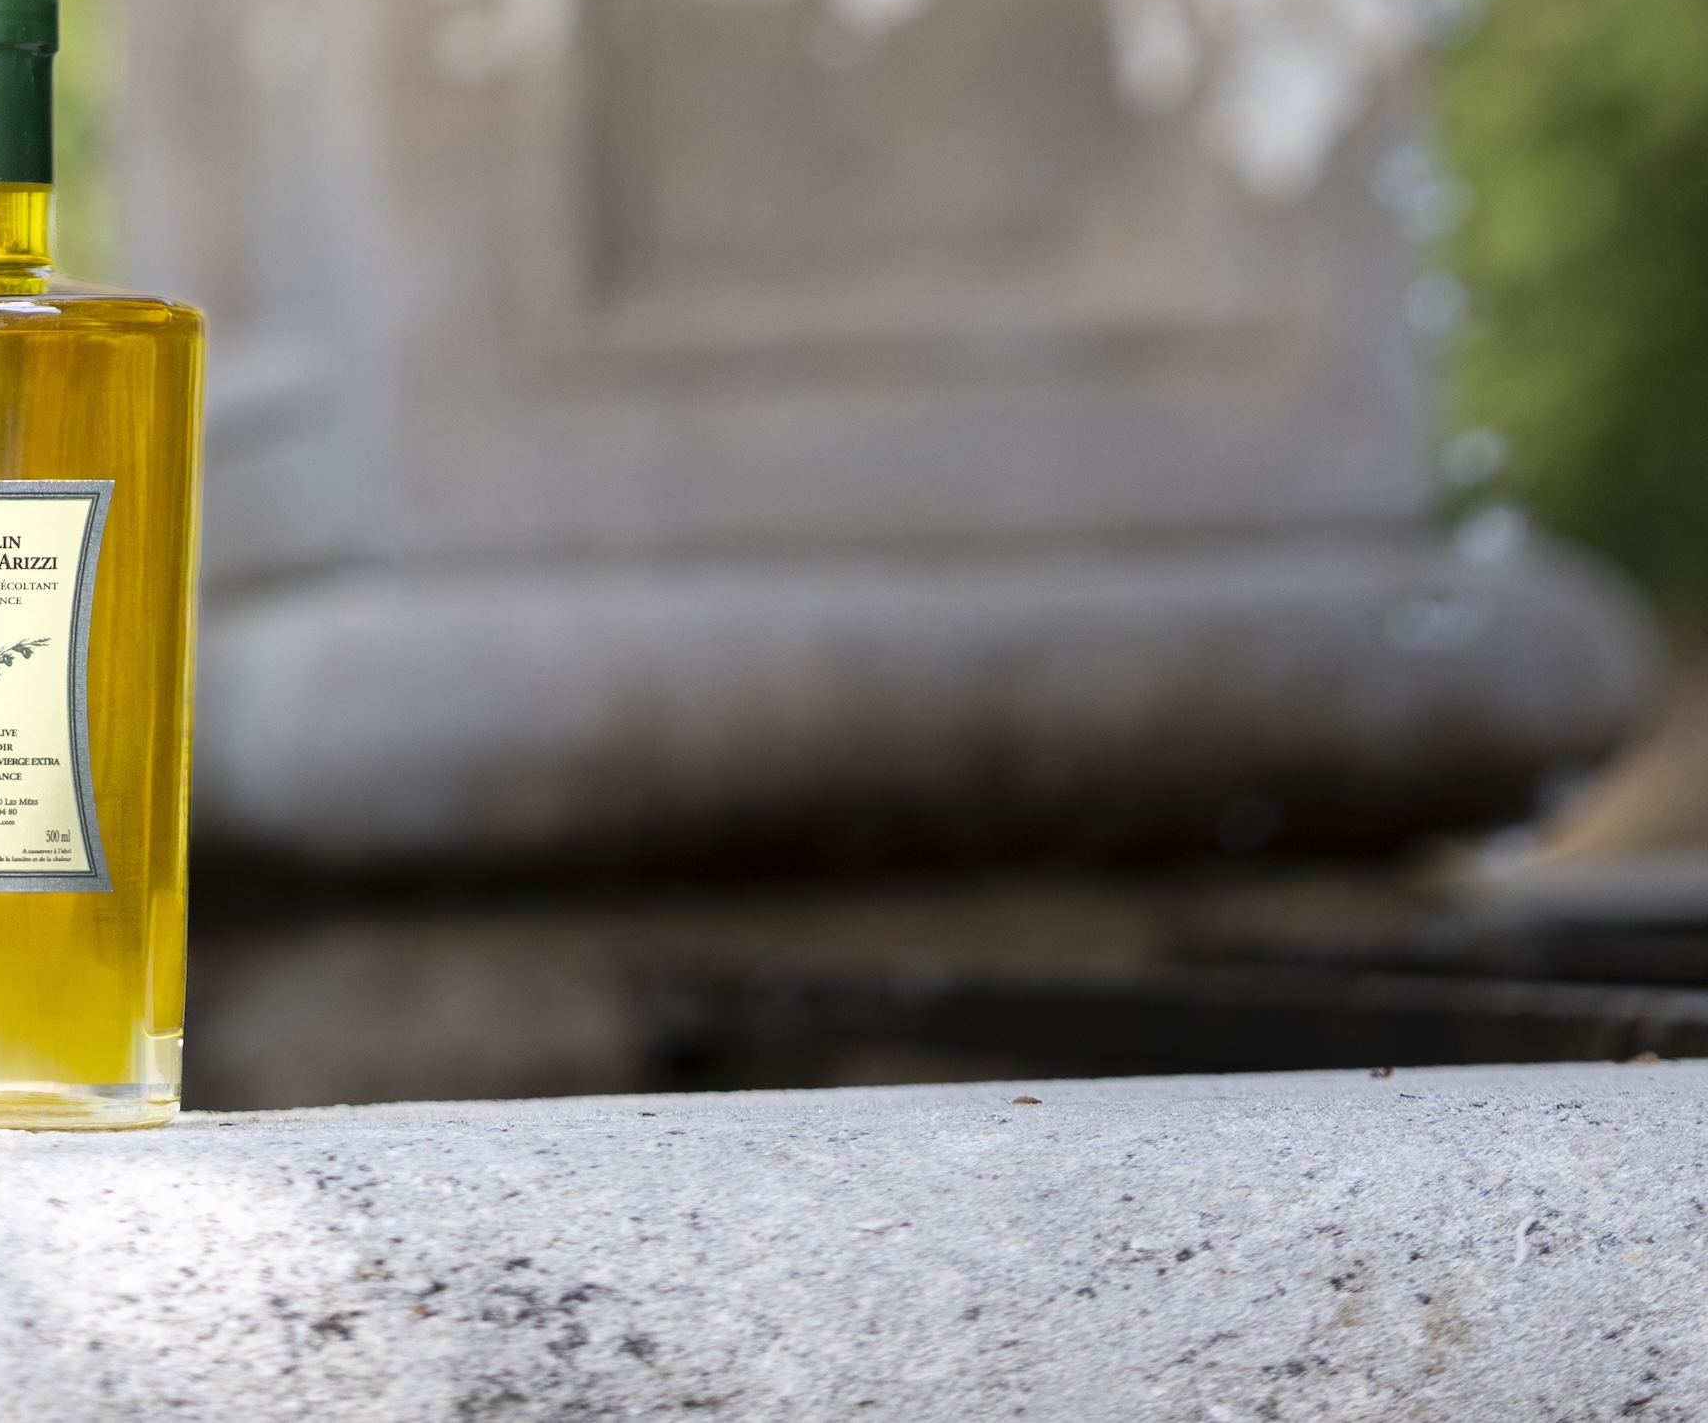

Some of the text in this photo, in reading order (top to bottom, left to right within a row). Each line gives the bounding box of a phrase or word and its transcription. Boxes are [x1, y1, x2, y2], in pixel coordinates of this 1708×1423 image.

[31, 757, 60, 765] EXTRA
[46, 829, 70, 842] 500 ml
